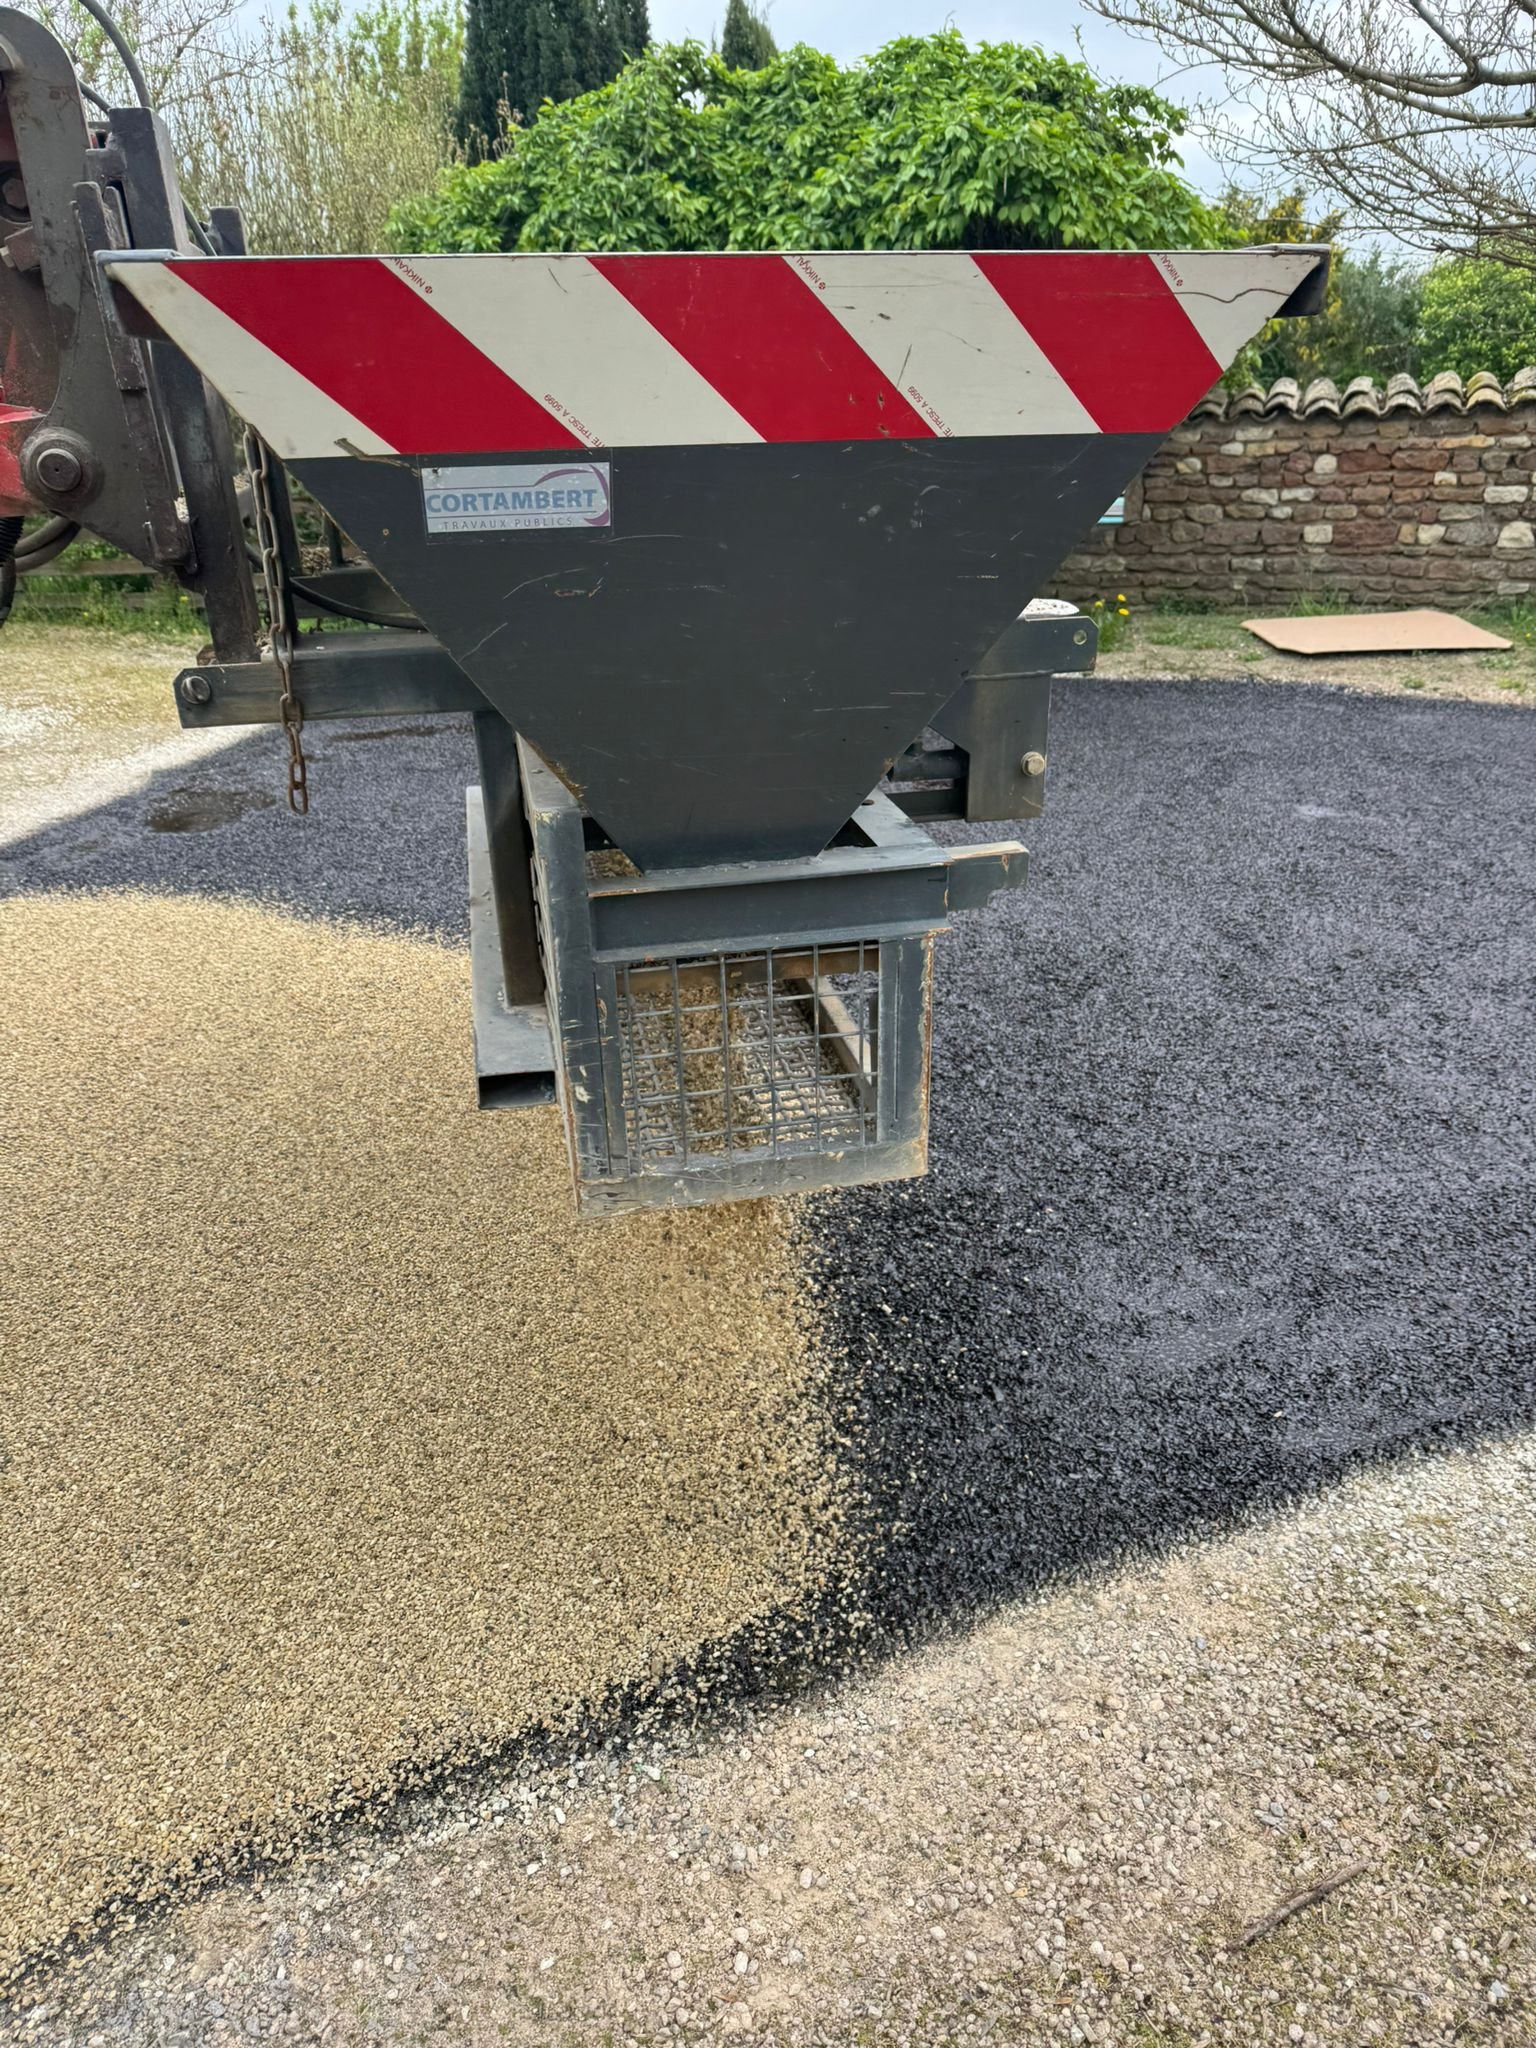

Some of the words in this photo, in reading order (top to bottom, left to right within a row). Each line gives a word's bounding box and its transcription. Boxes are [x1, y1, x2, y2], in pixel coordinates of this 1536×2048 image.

[907, 385, 924, 403] 5099
[544, 393, 564, 412] 5099
[921, 400, 929, 409] A
[562, 408, 571, 417] A
[426, 488, 598, 514] CORTAMBERT
[443, 518, 507, 531] TRAVAUX
[514, 516, 573, 528] PUBLICS
